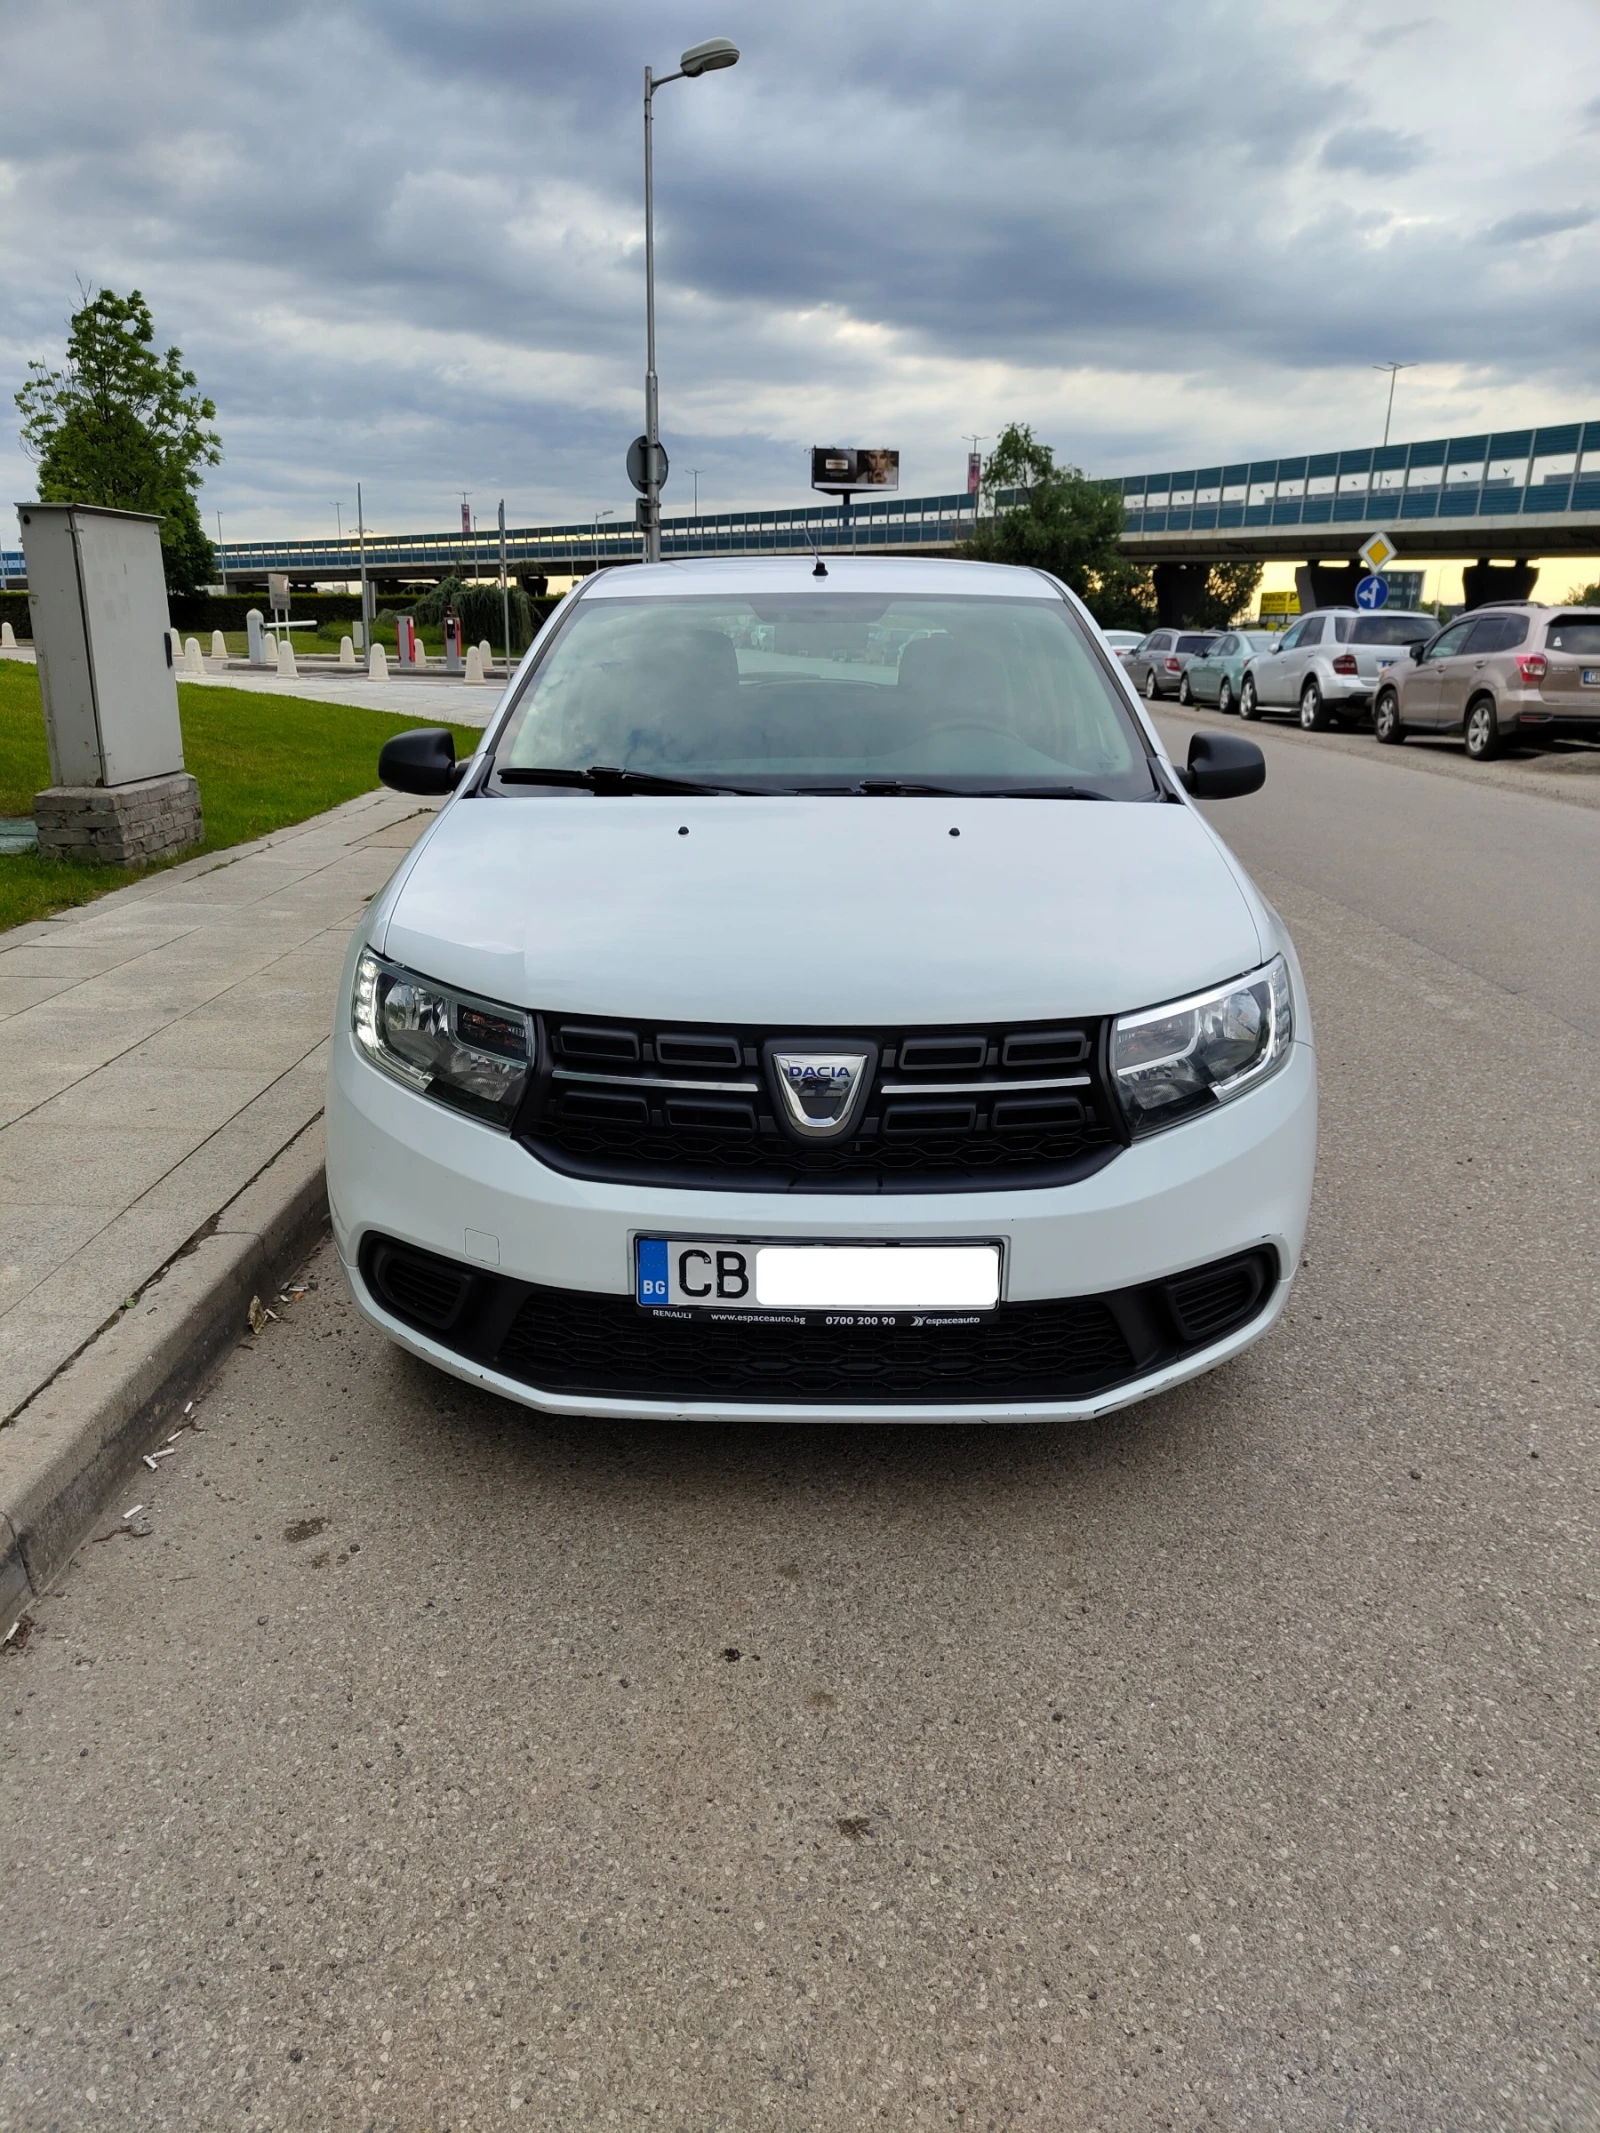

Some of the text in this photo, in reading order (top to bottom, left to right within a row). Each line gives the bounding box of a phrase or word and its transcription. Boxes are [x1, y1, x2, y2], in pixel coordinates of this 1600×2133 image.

[788, 1066, 851, 1078] DACIA
[678, 1249, 749, 1299] CB
[643, 1280, 666, 1295] BG
[710, 1313, 806, 1325] www.espaceauto.bg
[825, 1316, 896, 1325] 0700 200 90
[925, 1317, 981, 1326] espaceauto
